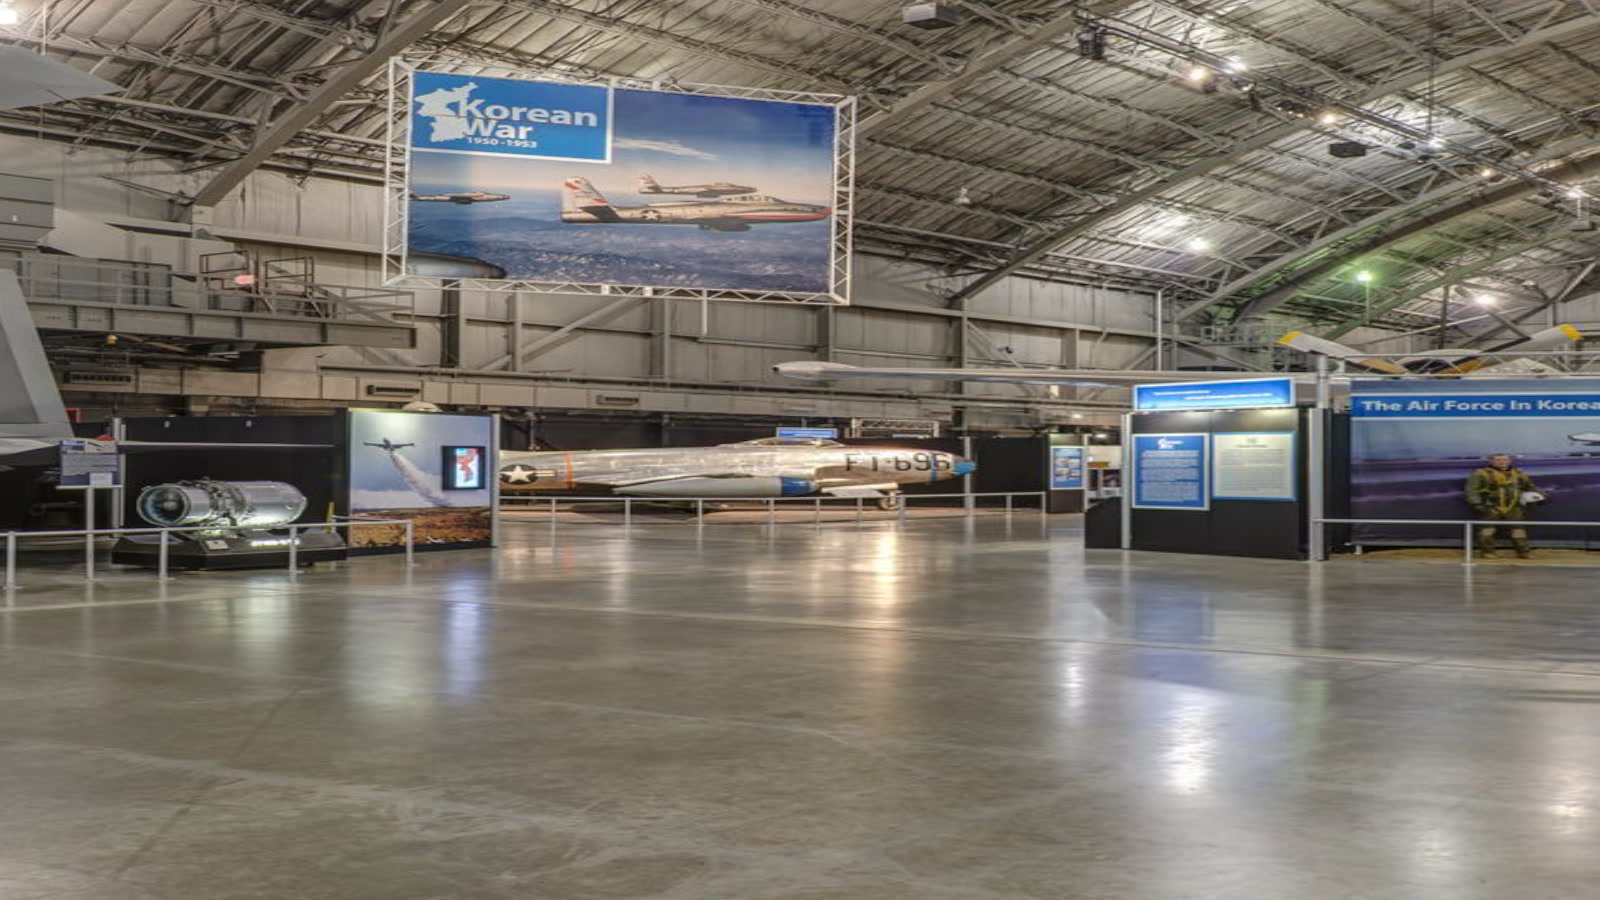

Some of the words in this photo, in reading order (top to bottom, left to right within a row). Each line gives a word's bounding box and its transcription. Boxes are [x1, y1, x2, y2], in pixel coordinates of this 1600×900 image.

[459, 99, 598, 127] Korean
[462, 119, 534, 140] War
[1361, 400, 1402, 412] The
[1407, 400, 1439, 412] Air
[1444, 399, 1506, 411] Force
[1510, 399, 1532, 411] In
